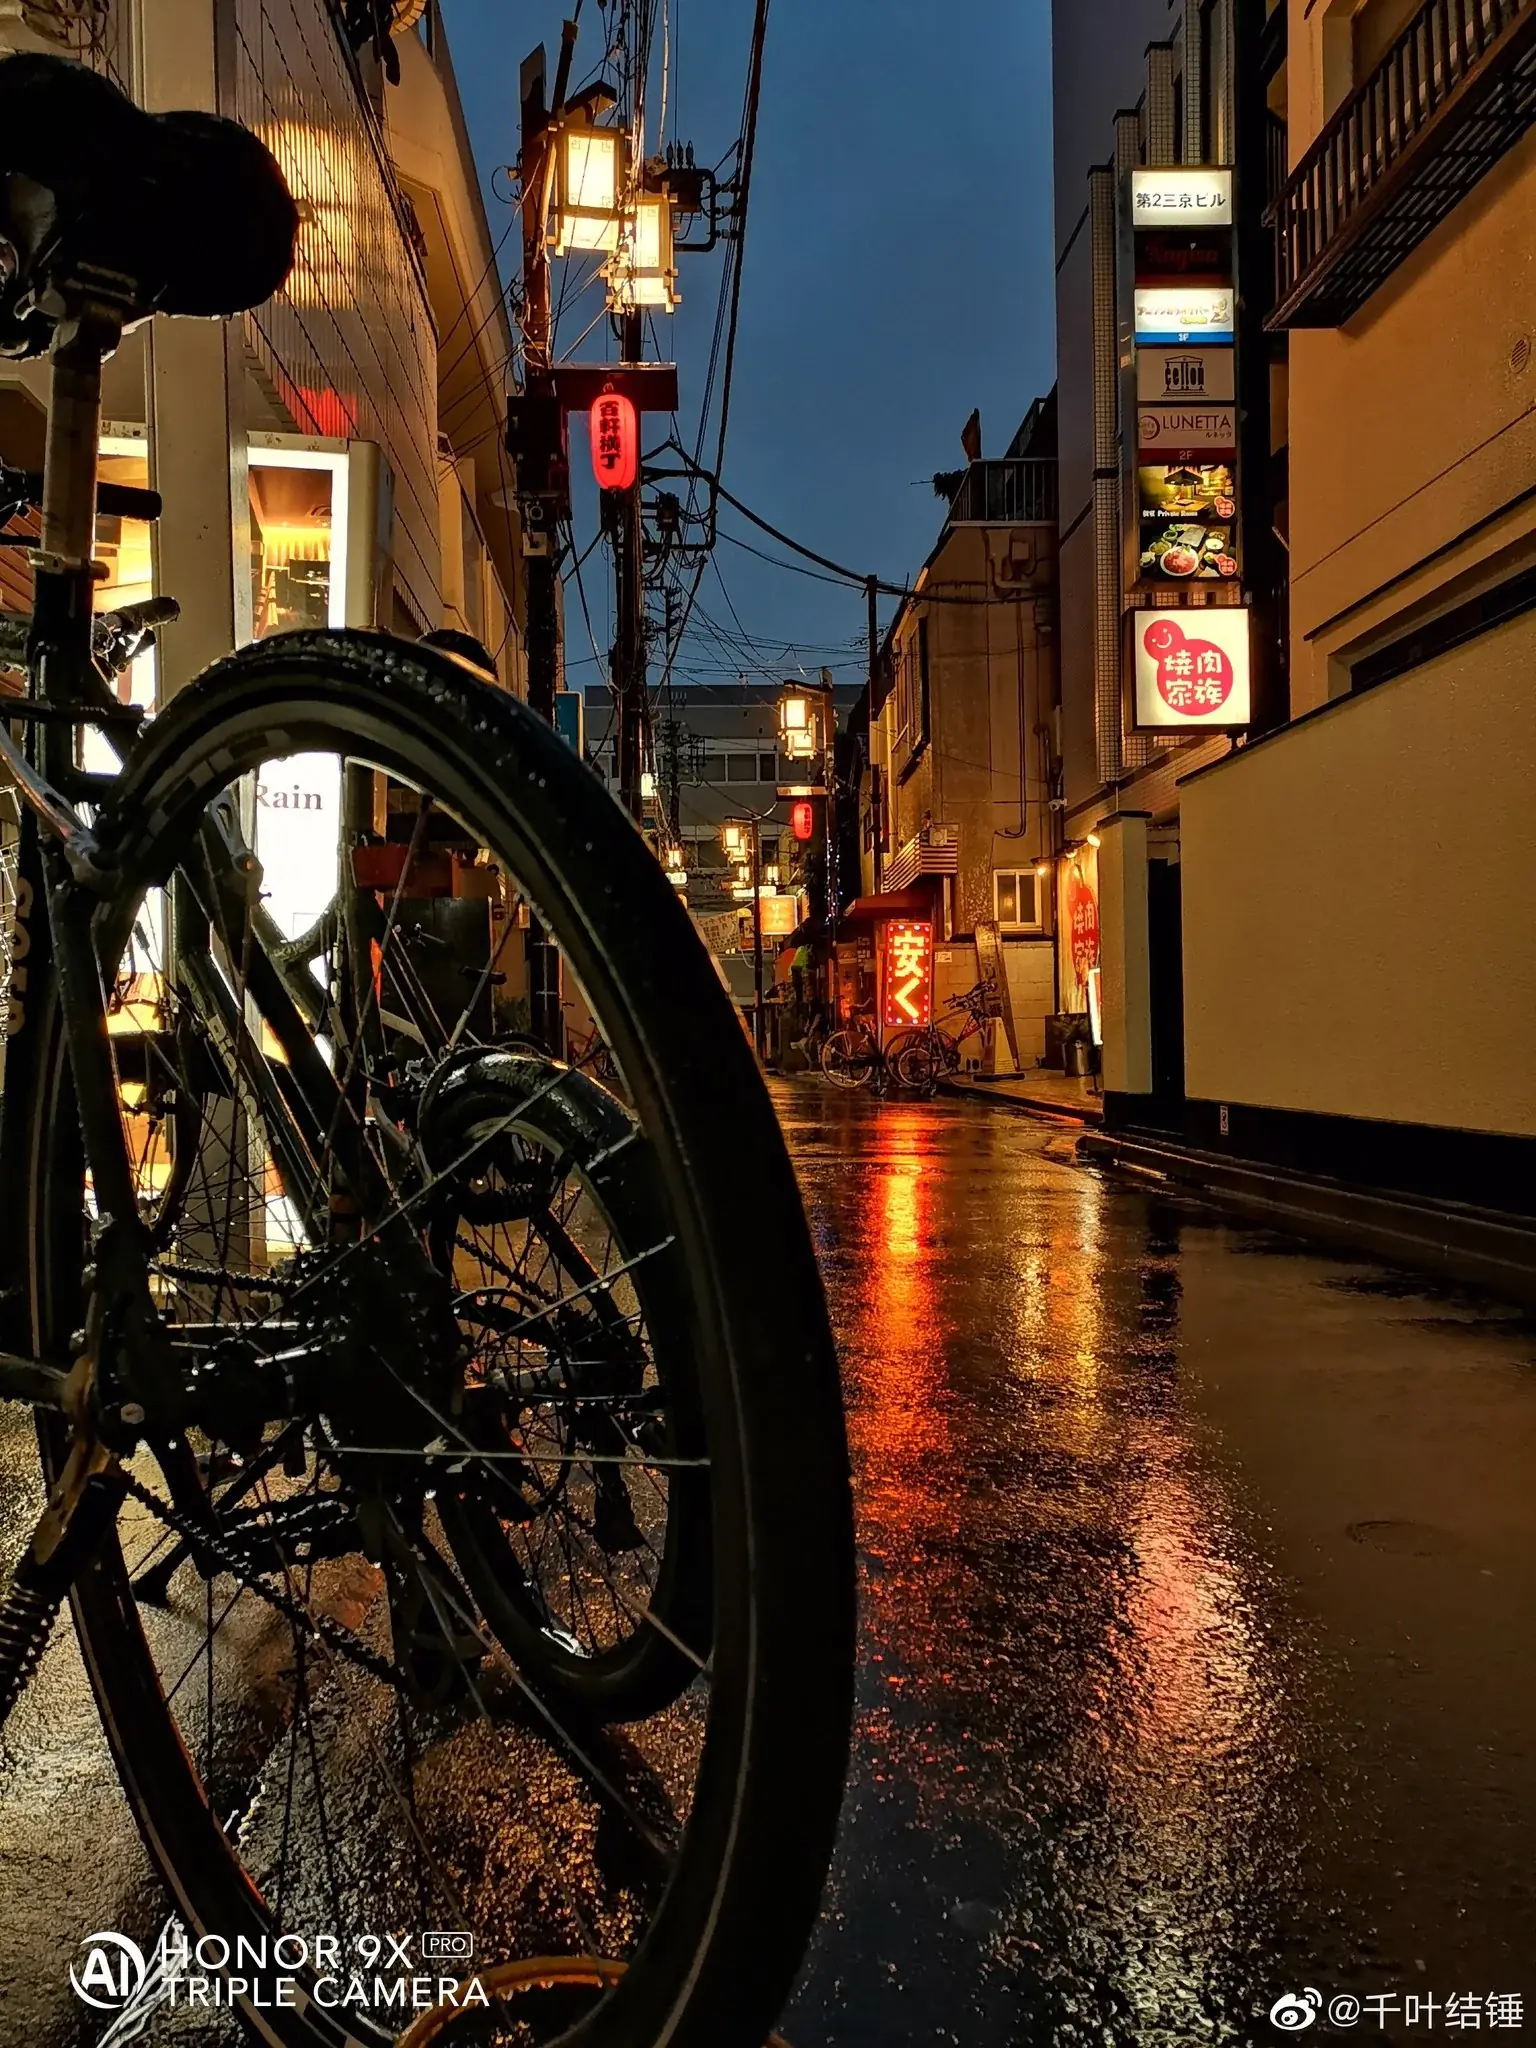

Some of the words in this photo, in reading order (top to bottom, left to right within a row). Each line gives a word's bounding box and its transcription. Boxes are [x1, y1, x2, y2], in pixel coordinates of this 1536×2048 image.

[1136, 192, 1226, 209] 第2三京ビル
[599, 400, 622, 470] 百軒横丁
[1162, 415, 1232, 429] LUNETTA
[1179, 450, 1193, 460] 2F
[1165, 677, 1222, 706] 家族
[255, 784, 323, 811] Rain
[893, 931, 925, 1018] 安く
